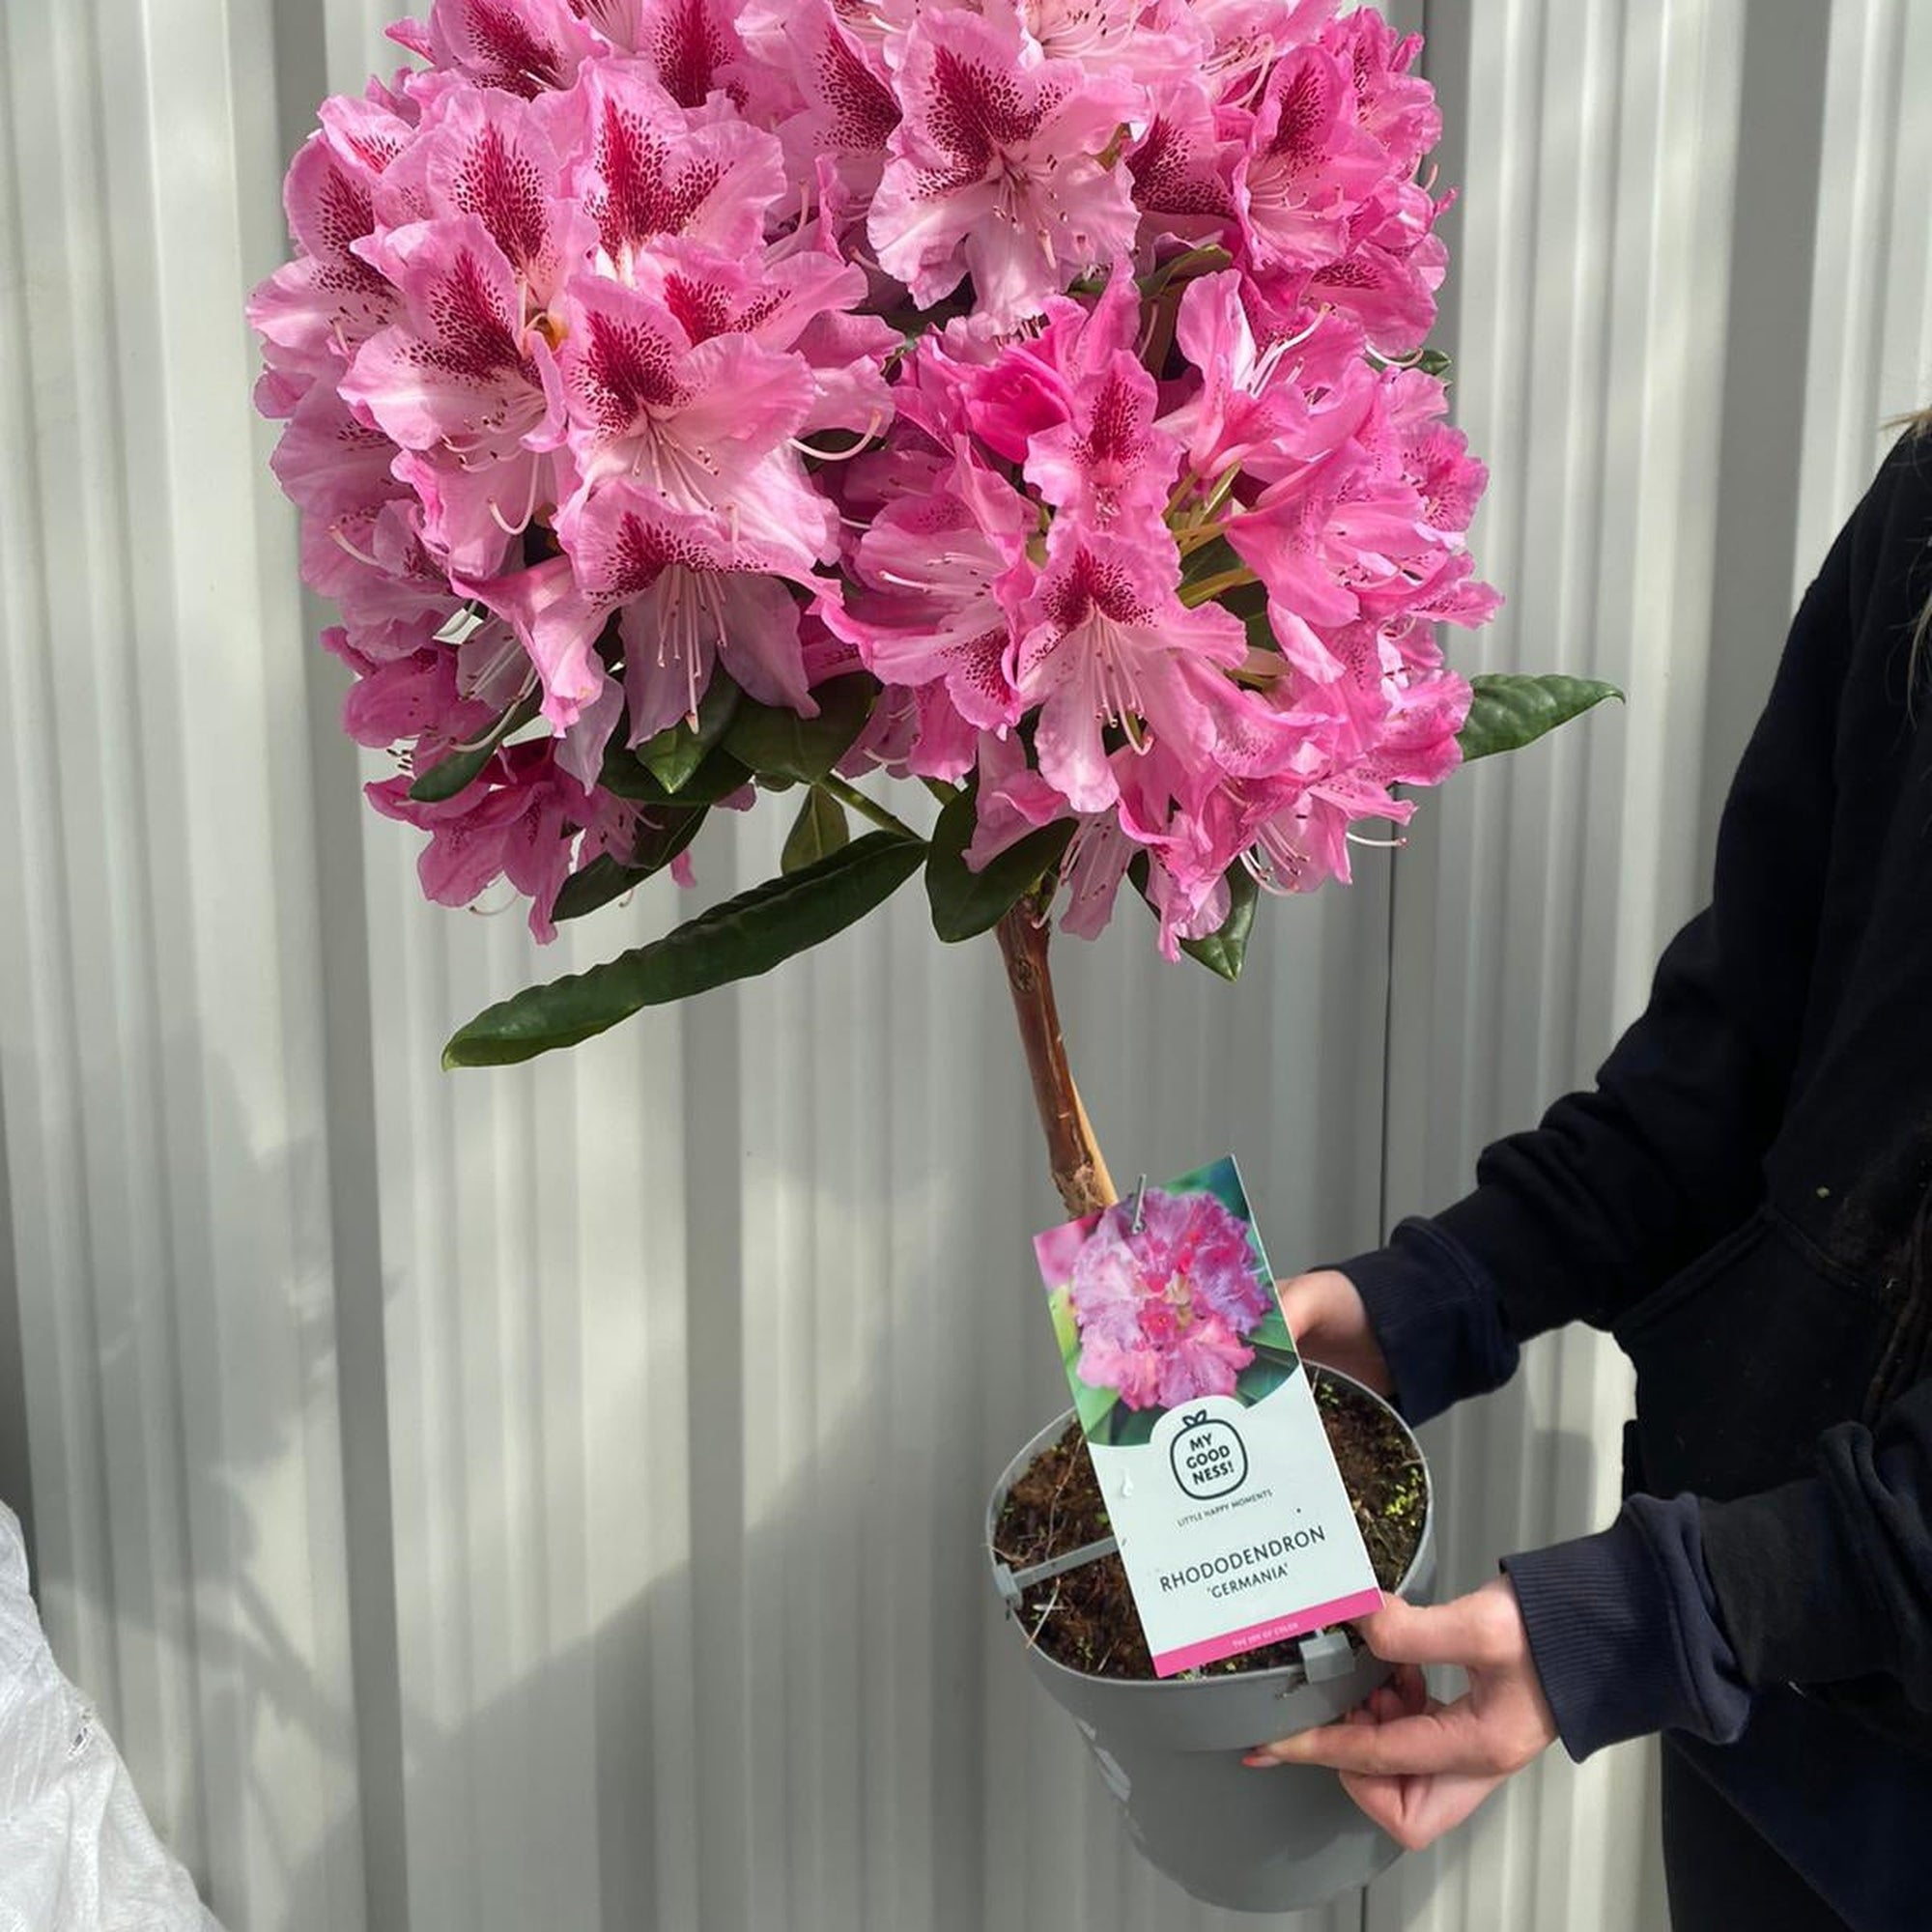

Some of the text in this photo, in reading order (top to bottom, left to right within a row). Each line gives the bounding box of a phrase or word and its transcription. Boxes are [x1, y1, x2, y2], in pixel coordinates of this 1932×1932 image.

[1186, 1445, 1231, 1469] GOOD
[1189, 1433, 1212, 1452] MY
[1192, 1461, 1235, 1485] NESS!
[1177, 1489, 1274, 1527] LITTLE HAPPY MOMENTS
[1159, 1525, 1326, 1592] RHODODENDRON
[1208, 1562, 1289, 1599] 'GERMANIA'
